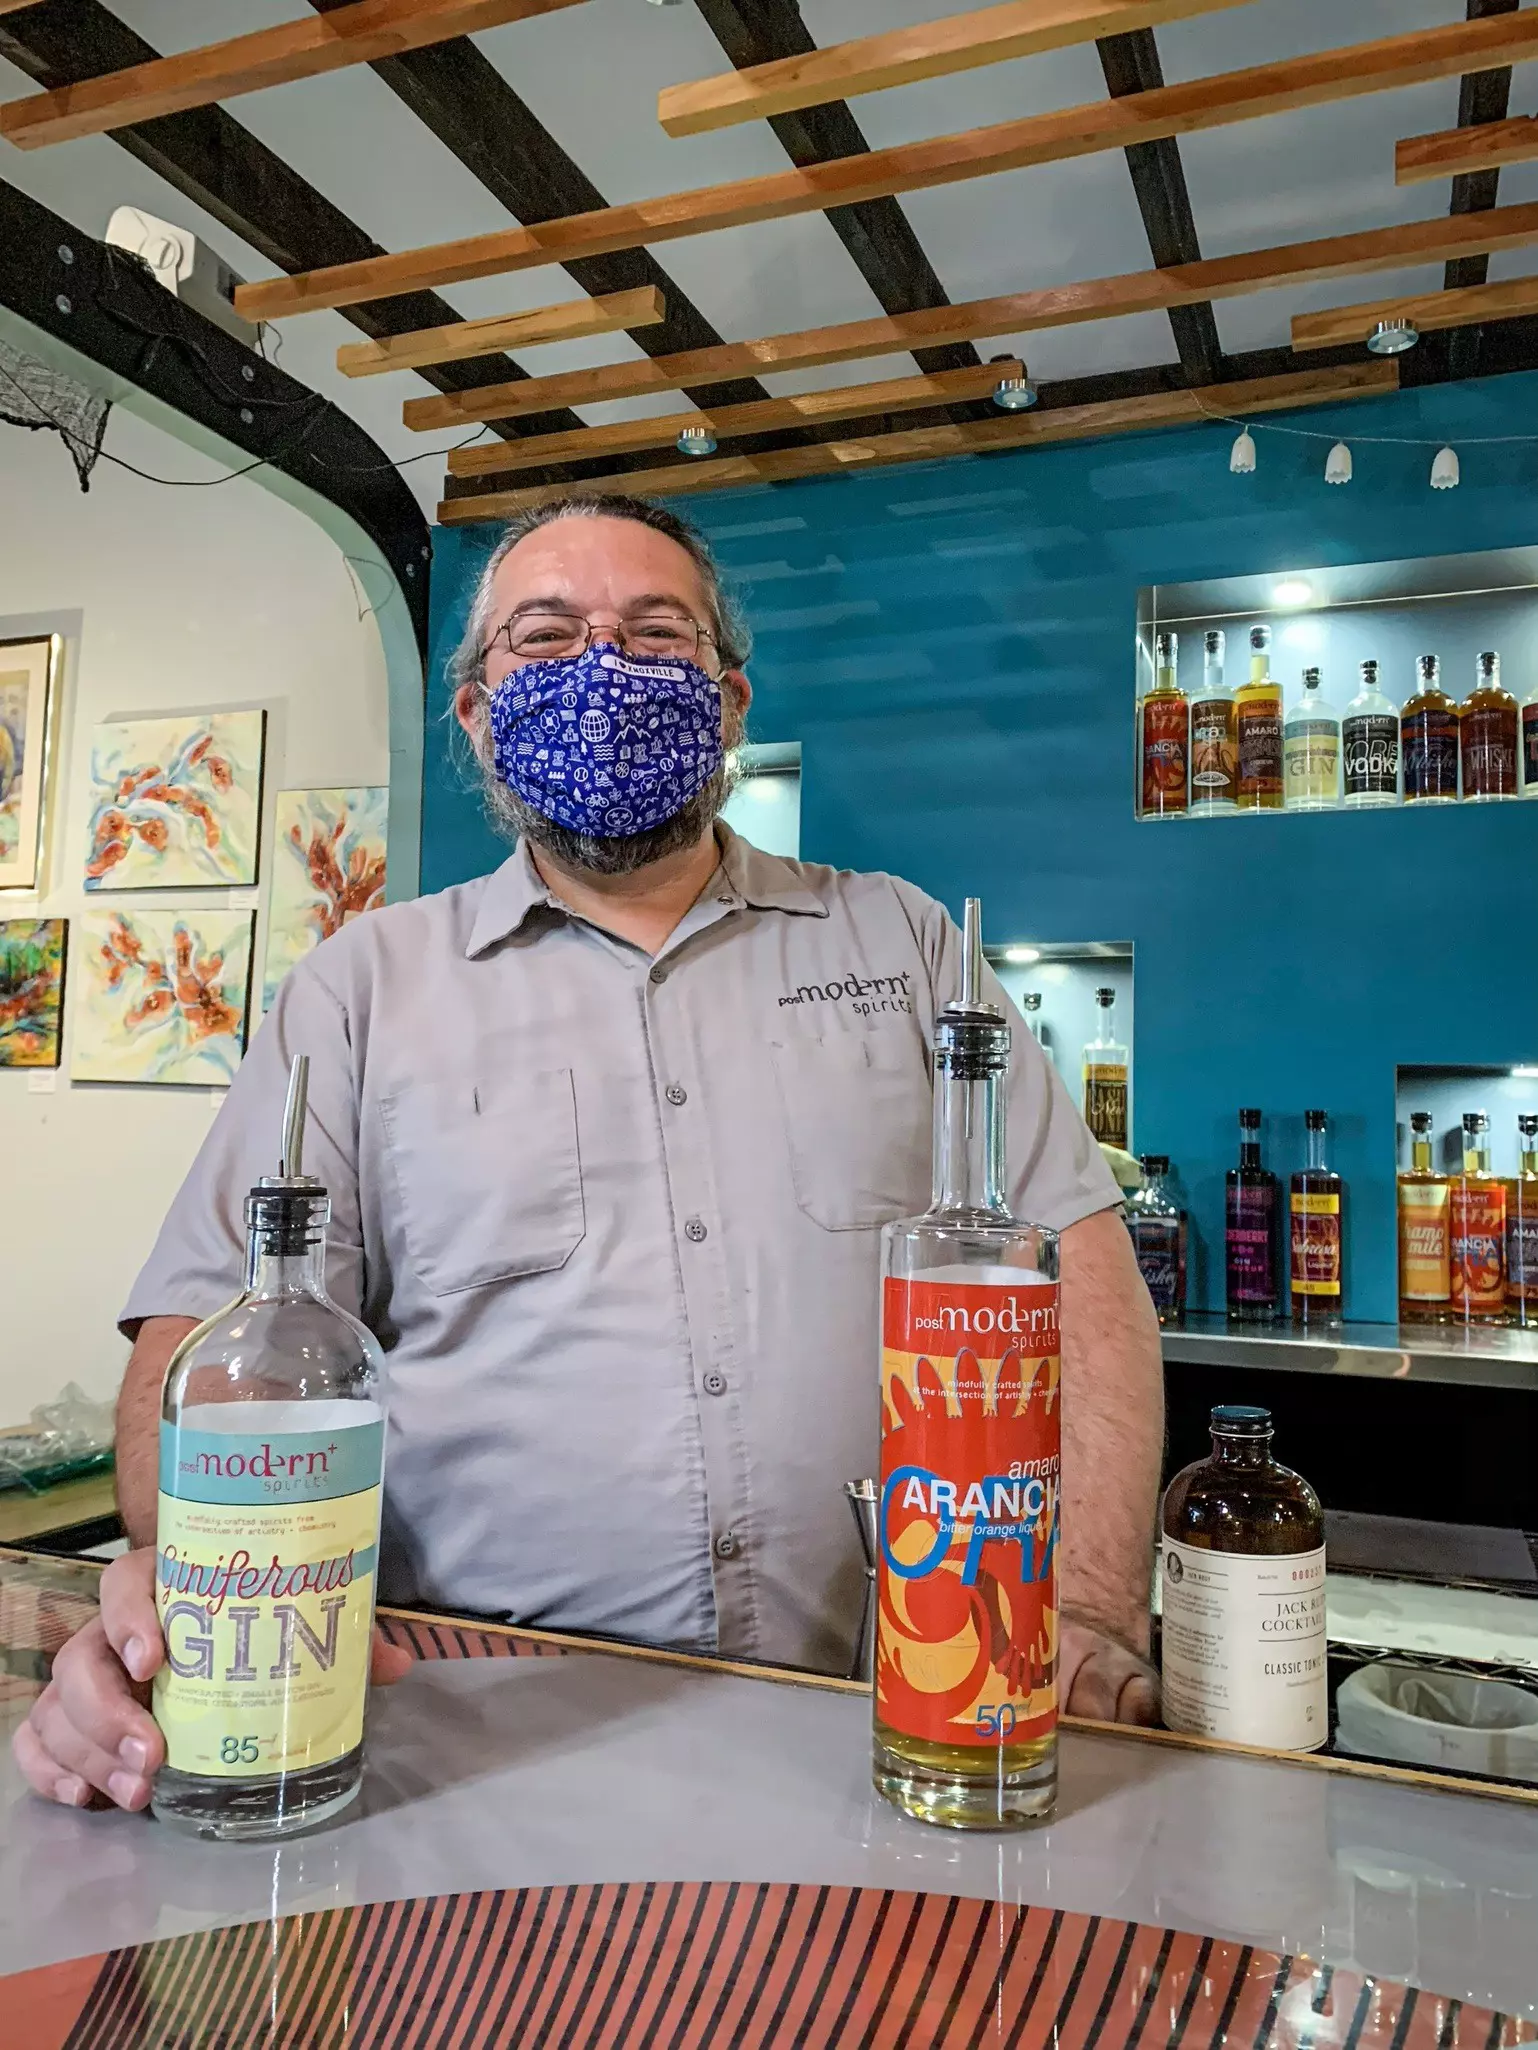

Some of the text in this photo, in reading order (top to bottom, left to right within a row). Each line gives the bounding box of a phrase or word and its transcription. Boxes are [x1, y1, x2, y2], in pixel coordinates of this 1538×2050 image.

[628, 665, 675, 678] KNOXVILLE
[1245, 726, 1279, 737] AMARO
[1290, 757, 1336, 777] GIN
[852, 997, 912, 1017] spirits
[1012, 1332, 1057, 1351] spirits
[922, 1387, 936, 1396] the
[938, 1389, 993, 1400] intersection
[995, 1390, 1003, 1400] of
[948, 1380, 989, 1390] mindfully
[992, 1380, 1021, 1389] crafted
[1008, 1453, 1060, 1481] amaro
[264, 1475, 329, 1494] spirits
[224, 1516, 256, 1526] crafted
[260, 1517, 292, 1527] spirits
[940, 1520, 973, 1534] bitter
[974, 1523, 1016, 1538] orange
[248, 1526, 286, 1537] artistry
[161, 1545, 355, 1616] Giniferous
[1277, 1601, 1307, 1617] JACK
[163, 1594, 347, 1681] GIN
[1264, 1661, 1302, 1675] CLASSIC
[976, 1703, 1017, 1737] 50
[220, 1735, 259, 1764] 85
